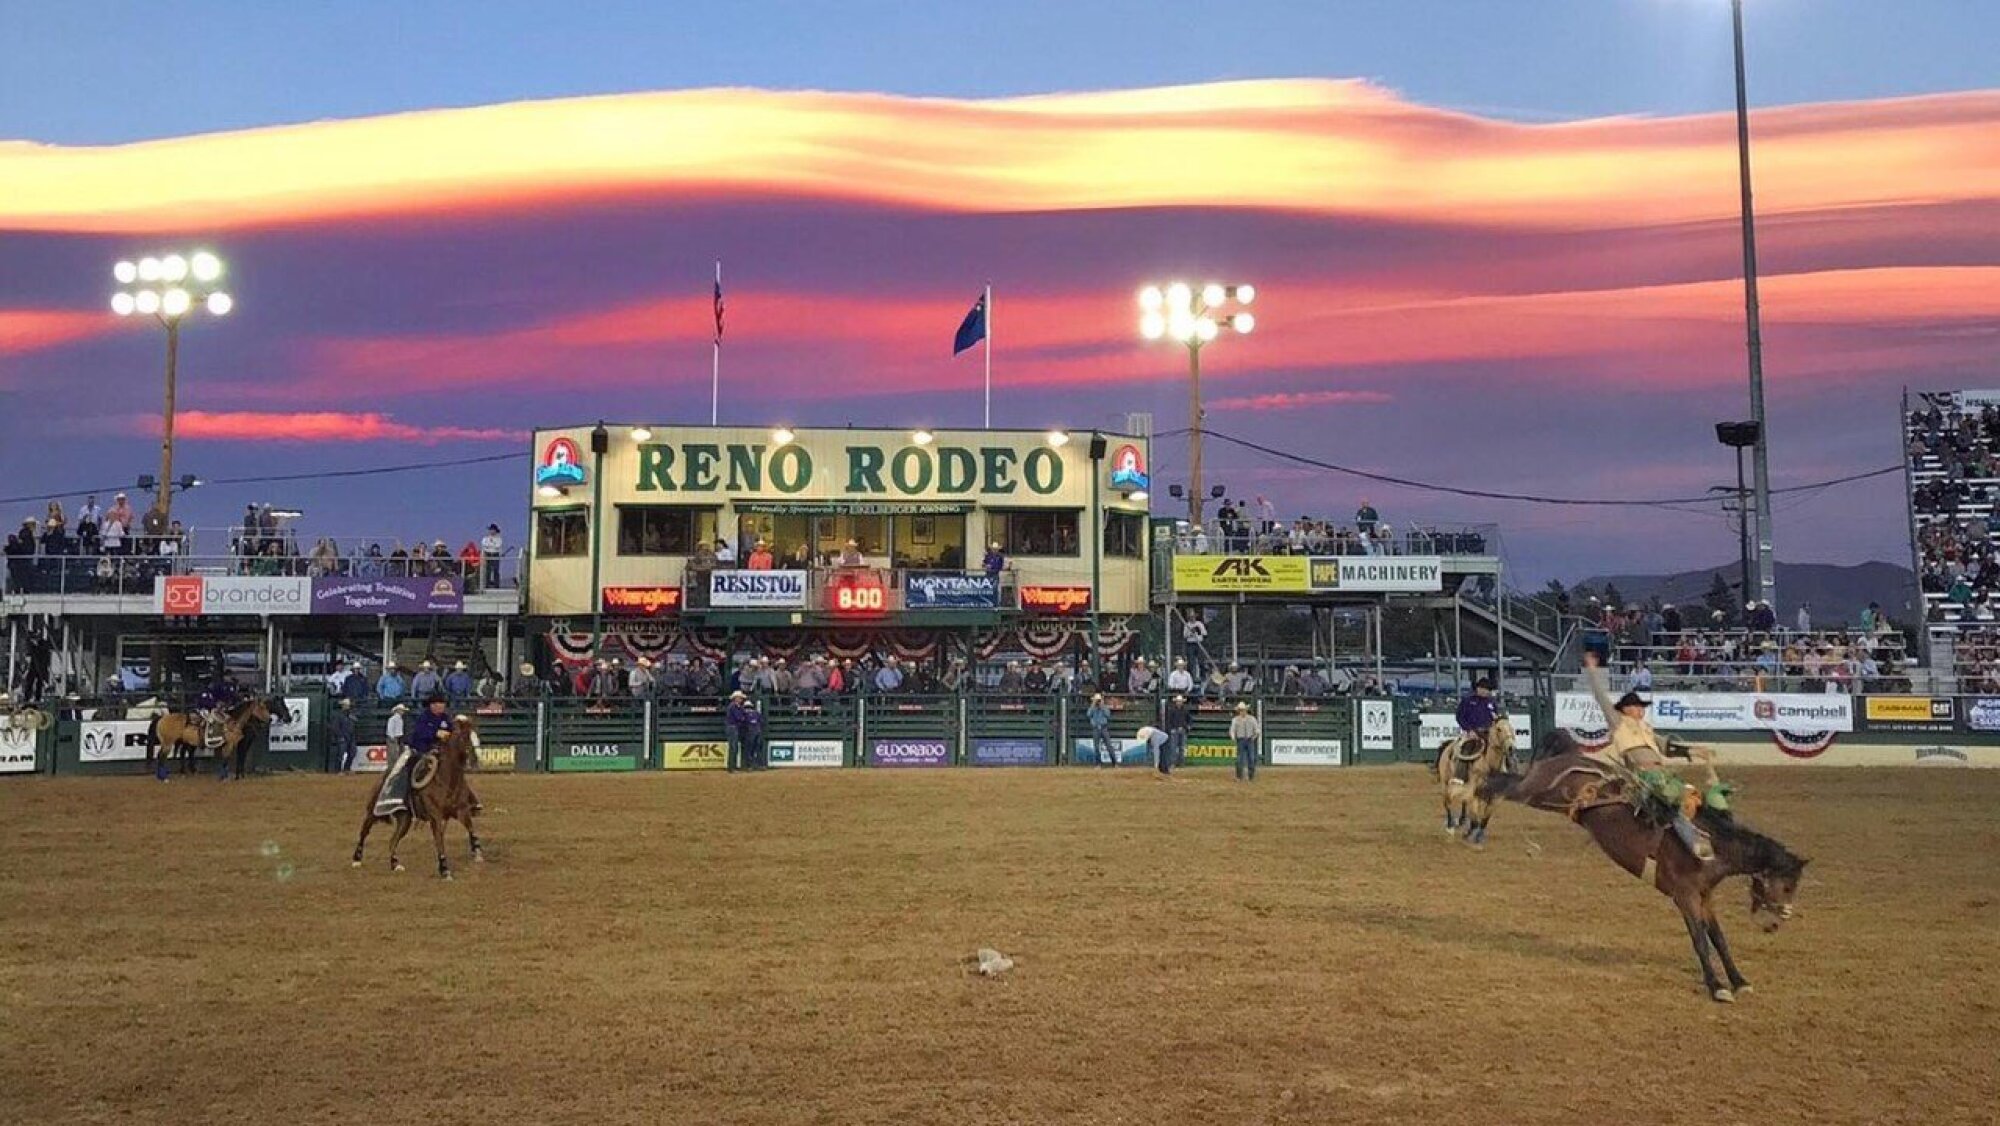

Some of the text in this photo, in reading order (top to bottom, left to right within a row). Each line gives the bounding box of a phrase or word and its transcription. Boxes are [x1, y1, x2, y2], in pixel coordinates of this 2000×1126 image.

[635, 444, 1064, 495] RENO RODEO
[1342, 565, 1438, 580] MACHINERY
[713, 576, 801, 593] RESISTOL
[909, 577, 994, 589] MONTANA
[206, 580, 301, 602] branded
[316, 582, 416, 600] Celebrating Tradition
[344, 595, 390, 608] Together
[604, 588, 679, 611] Wrangler
[1021, 588, 1090, 610] Wrangler
[1777, 705, 1847, 718] campbell
[1932, 703, 1950, 714] CAT
[571, 745, 619, 756] DALLAS
[876, 744, 945, 756] ELDORADO
